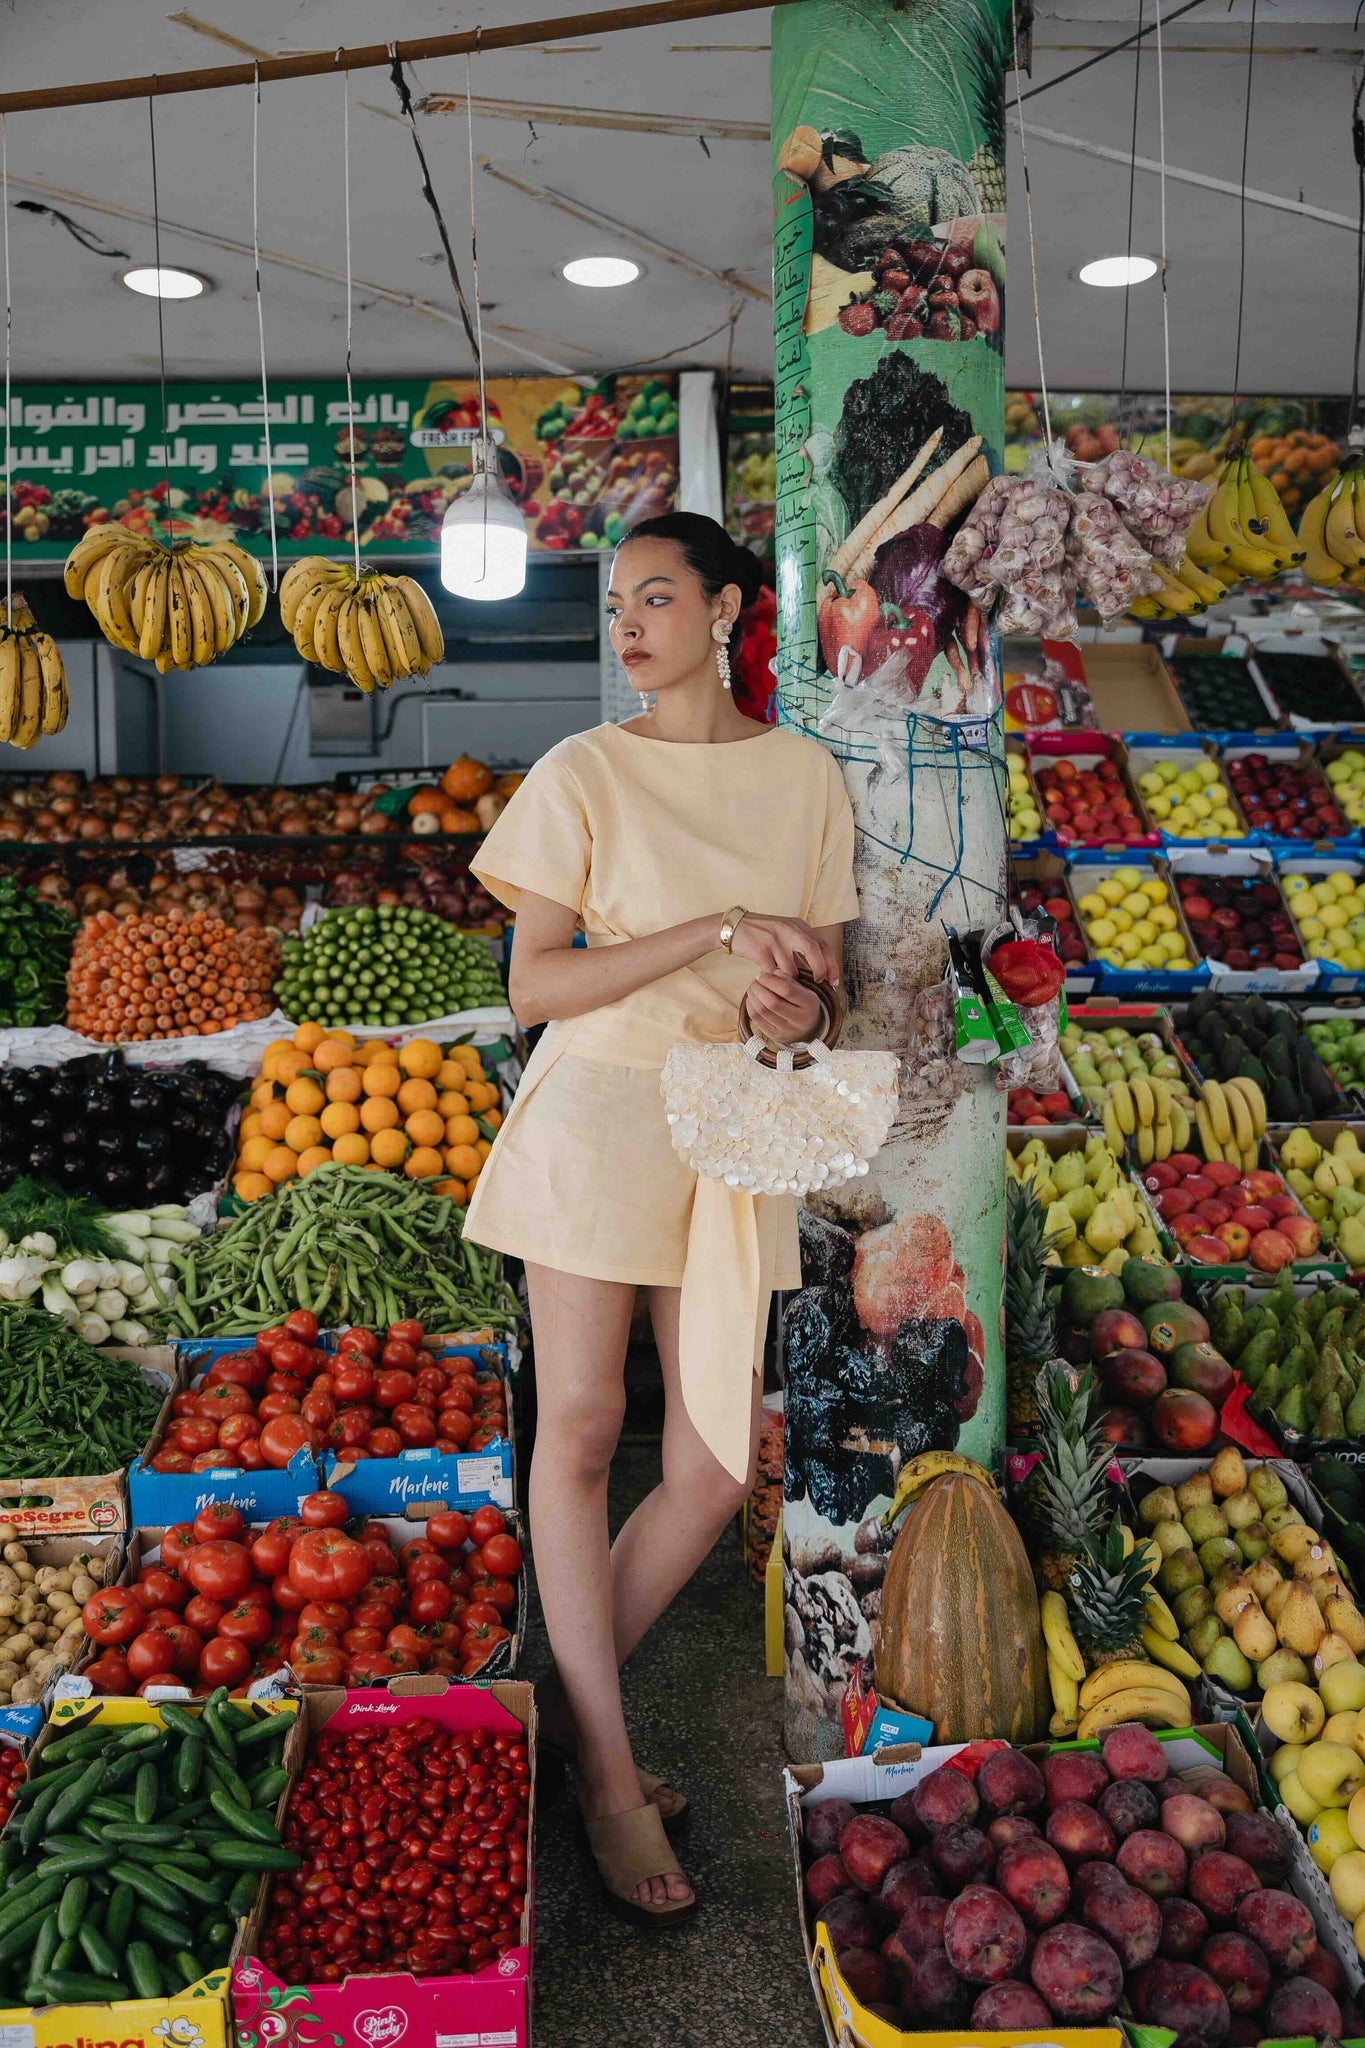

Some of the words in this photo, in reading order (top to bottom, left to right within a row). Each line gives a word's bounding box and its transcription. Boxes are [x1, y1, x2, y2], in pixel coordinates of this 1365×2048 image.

[0, 397, 145, 434] والفوا
[161, 394, 314, 433] الخضر
[326, 393, 409, 428] بائع
[146, 437, 218, 474] ولد
[229, 437, 309, 466] عند
[389, 1474, 449, 1501] Marlene
[349, 1703, 374, 1715] Pink
[374, 1703, 398, 1714] Lady
[363, 2009, 397, 2032] Pink
[368, 2021, 404, 2041] Lady
